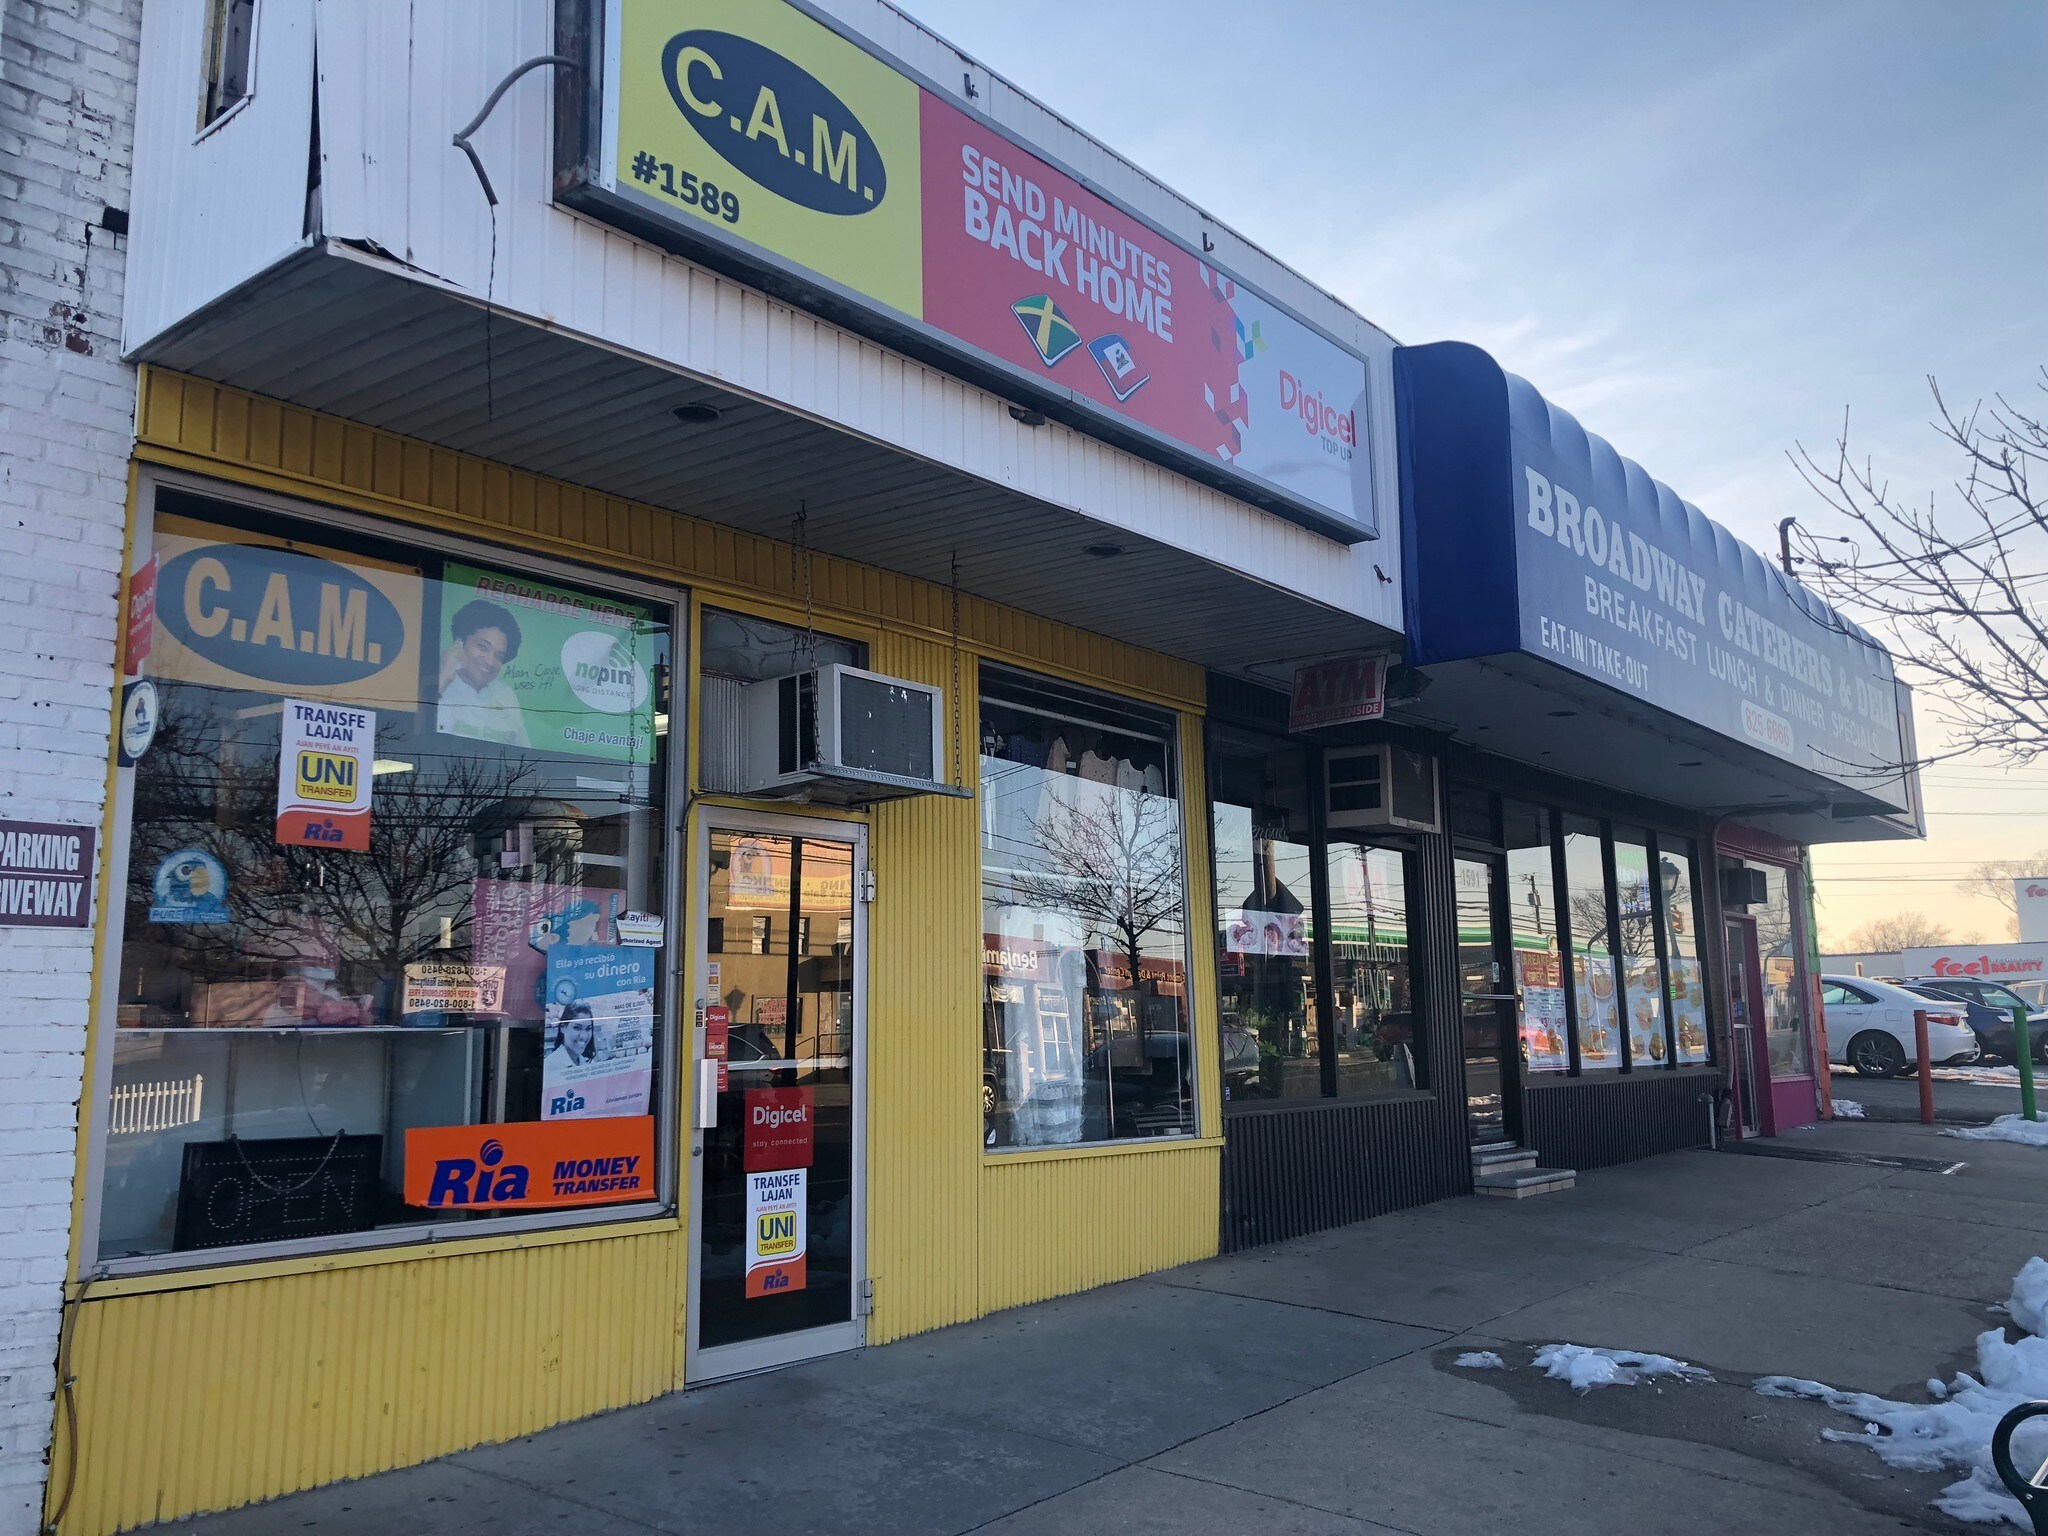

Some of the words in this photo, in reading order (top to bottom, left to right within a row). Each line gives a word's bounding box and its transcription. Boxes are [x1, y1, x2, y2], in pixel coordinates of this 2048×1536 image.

[676, 46, 874, 202] C.A.M.
[631, 150, 740, 223] #1589
[961, 144, 1045, 221] SEND
[1054, 199, 1172, 297] MINUTES
[964, 186, 1070, 286] BACK
[1076, 248, 1174, 344] HOME
[1279, 370, 1357, 447] Digicel
[1321, 437, 1339, 459] TOP
[1340, 442, 1353, 463] UP
[183, 557, 382, 664] C.A.M.
[475, 576, 584, 618] RECHARGE
[588, 602, 636, 630] HERE
[1525, 465, 1706, 626] BROADWAY
[1718, 591, 1833, 698] CATERERS
[1839, 666, 1853, 711] &
[1855, 676, 1896, 733] DELI
[575, 661, 633, 687] nopin
[1584, 575, 1697, 666] BREAKFAST
[1707, 641, 1757, 699] LUNCH
[1765, 676, 1775, 707] &
[1780, 682, 1826, 731] DINNER
[1831, 710, 1878, 751] SPECIALS
[572, 684, 590, 694] LONG
[591, 687, 632, 699] DISTANCE
[1295, 661, 1376, 711] ATM
[294, 705, 366, 729] TRANSFE
[1344, 703, 1380, 717] INSIDE
[305, 723, 353, 742] LAJAN
[563, 727, 596, 744] Chaje
[598, 731, 644, 750] Avantaj!
[1745, 707, 1790, 748] 825-6666
[301, 755, 354, 786] UNI
[301, 784, 352, 798] TRANSFER
[303, 818, 344, 843] Ria
[1460, 867, 1480, 888] 1591
[0, 879, 83, 917] IVEWAY
[626, 912, 649, 923] ayiti
[556, 959, 573, 969] Ella
[573, 959, 584, 968] ya
[585, 952, 616, 966] recibió
[585, 972, 595, 980] su
[597, 961, 641, 978] dinero
[1931, 955, 1989, 977] feel
[1991, 961, 2043, 973] BEAUTY
[616, 979, 631, 987] con
[633, 975, 646, 984] Ria
[1355, 968, 1392, 1010] LUNCH
[550, 1089, 585, 1116] Ria
[753, 1104, 807, 1129] Digicel
[753, 1140, 768, 1148] stay
[770, 1137, 808, 1147] connected
[427, 1139, 529, 1207] Ria
[553, 1156, 641, 1180] MONEY
[553, 1176, 641, 1197] TRANSFER
[754, 1173, 800, 1190] TRANSFE
[208, 1169, 357, 1229] OPEN
[761, 1187, 793, 1202] LAJAN
[760, 1215, 794, 1241] UNI
[760, 1240, 794, 1252] TRANSFER
[763, 1268, 789, 1290] Ria
